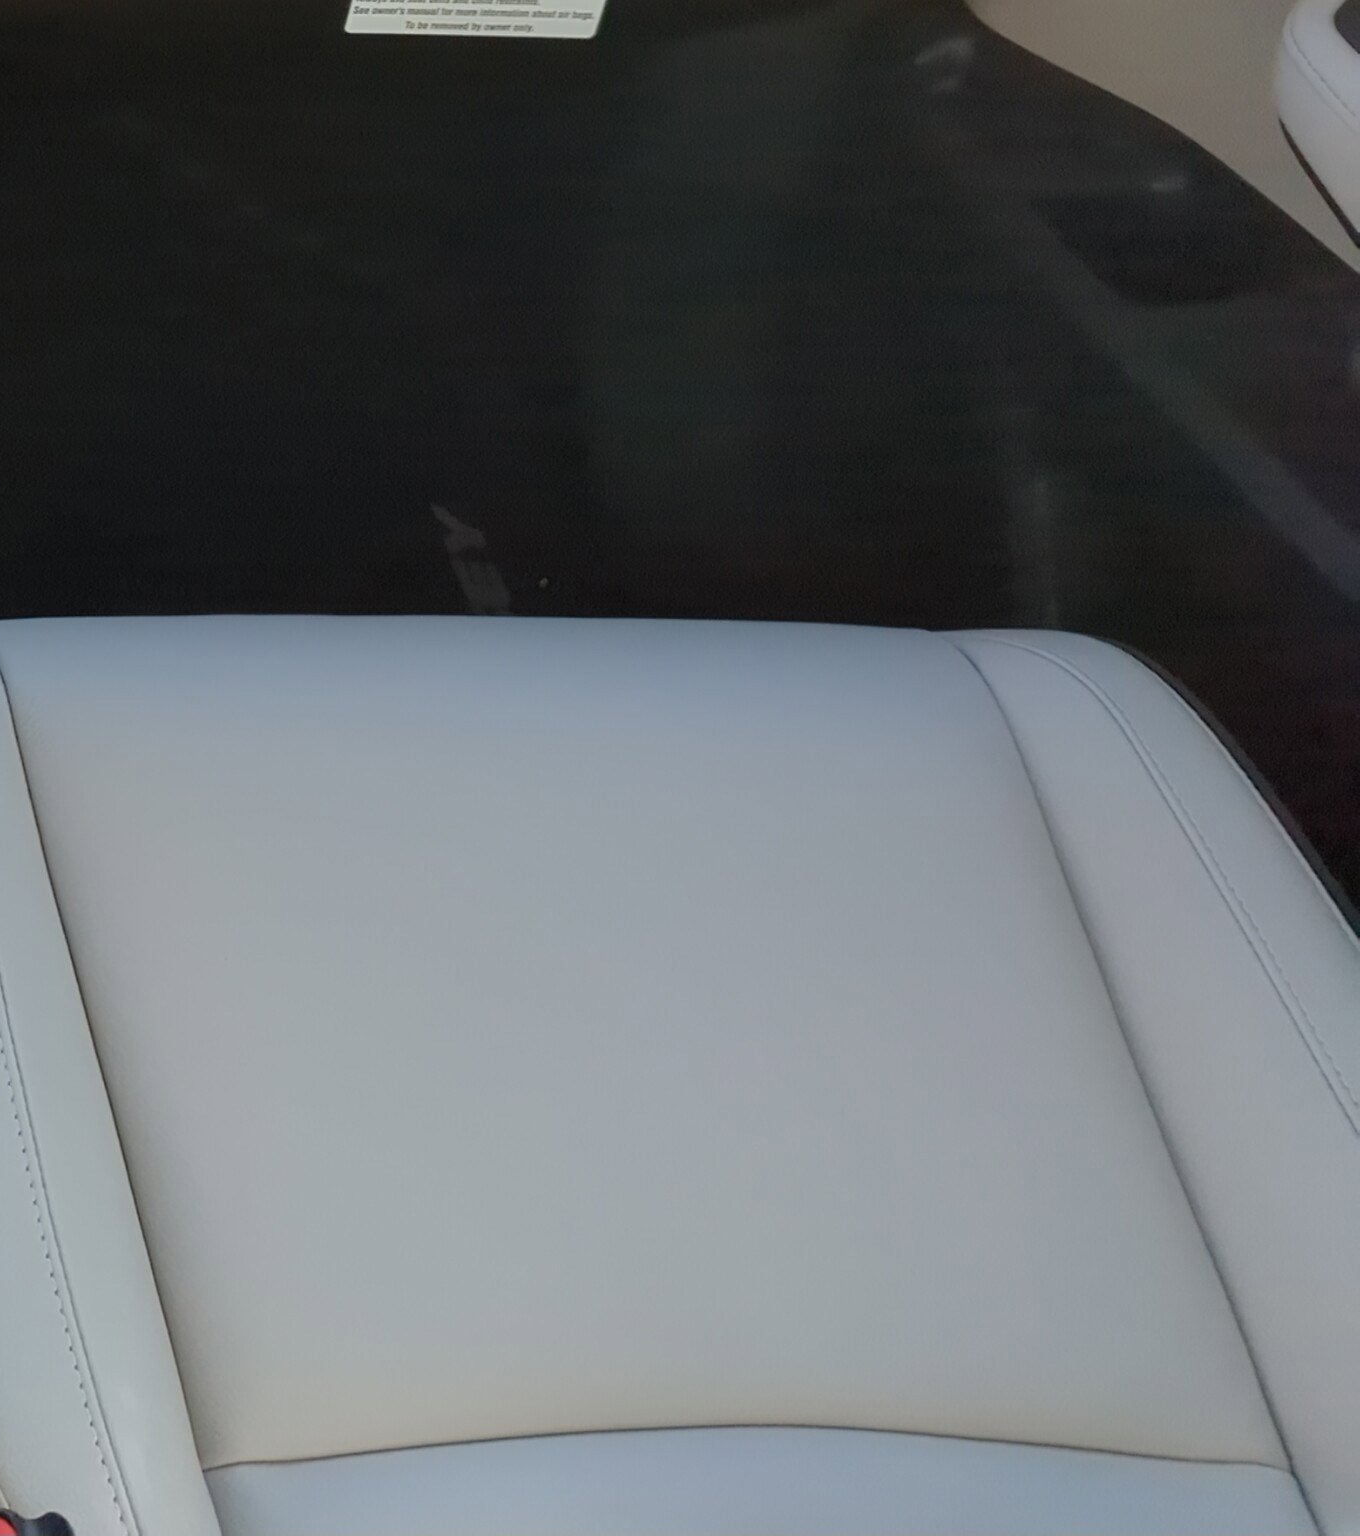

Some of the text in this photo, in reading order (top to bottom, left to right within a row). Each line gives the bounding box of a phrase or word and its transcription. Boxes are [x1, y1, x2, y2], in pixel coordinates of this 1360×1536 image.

[405, 20, 416, 30] To
[417, 21, 428, 30] be
[430, 22, 469, 31] removed
[471, 22, 480, 32] by
[513, 23, 534, 32] only.
